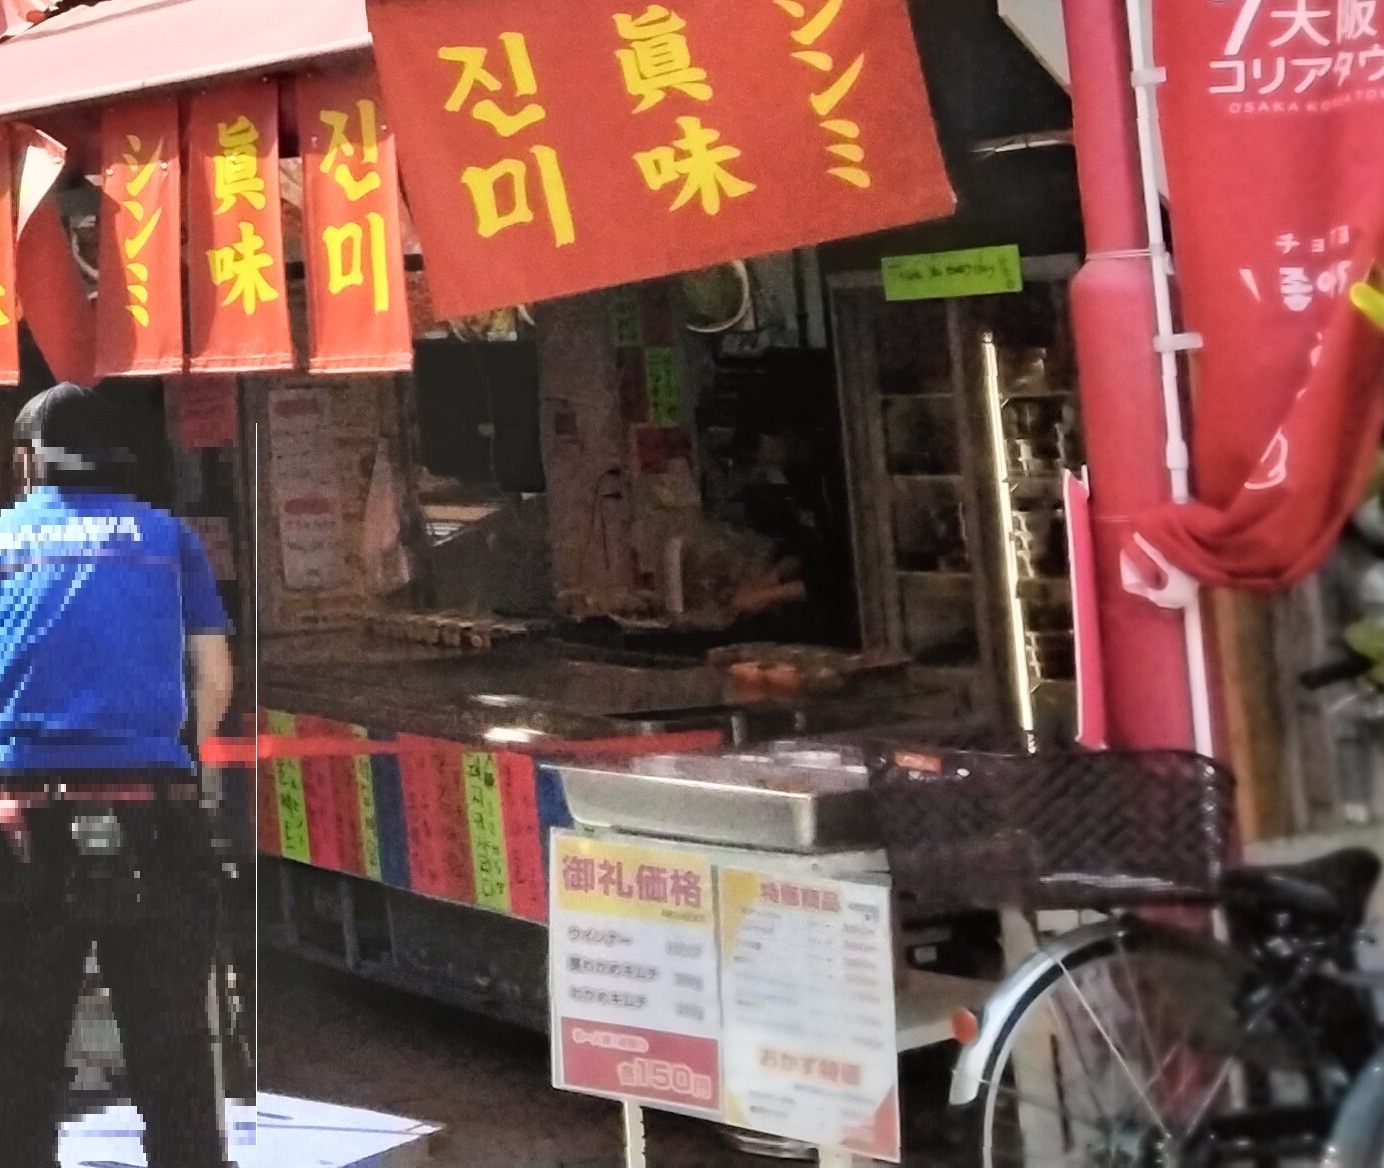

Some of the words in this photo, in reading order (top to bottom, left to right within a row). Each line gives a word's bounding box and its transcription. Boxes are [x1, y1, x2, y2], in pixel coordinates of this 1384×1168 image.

[319, 98, 391, 314] 진미
[438, 31, 576, 248] 진미
[612, 4, 757, 217] 眞味
[1229, 101, 1300, 114] OSAKA
[123, 132, 163, 329] シンミ
[562, 854, 702, 909] 御礼価格
